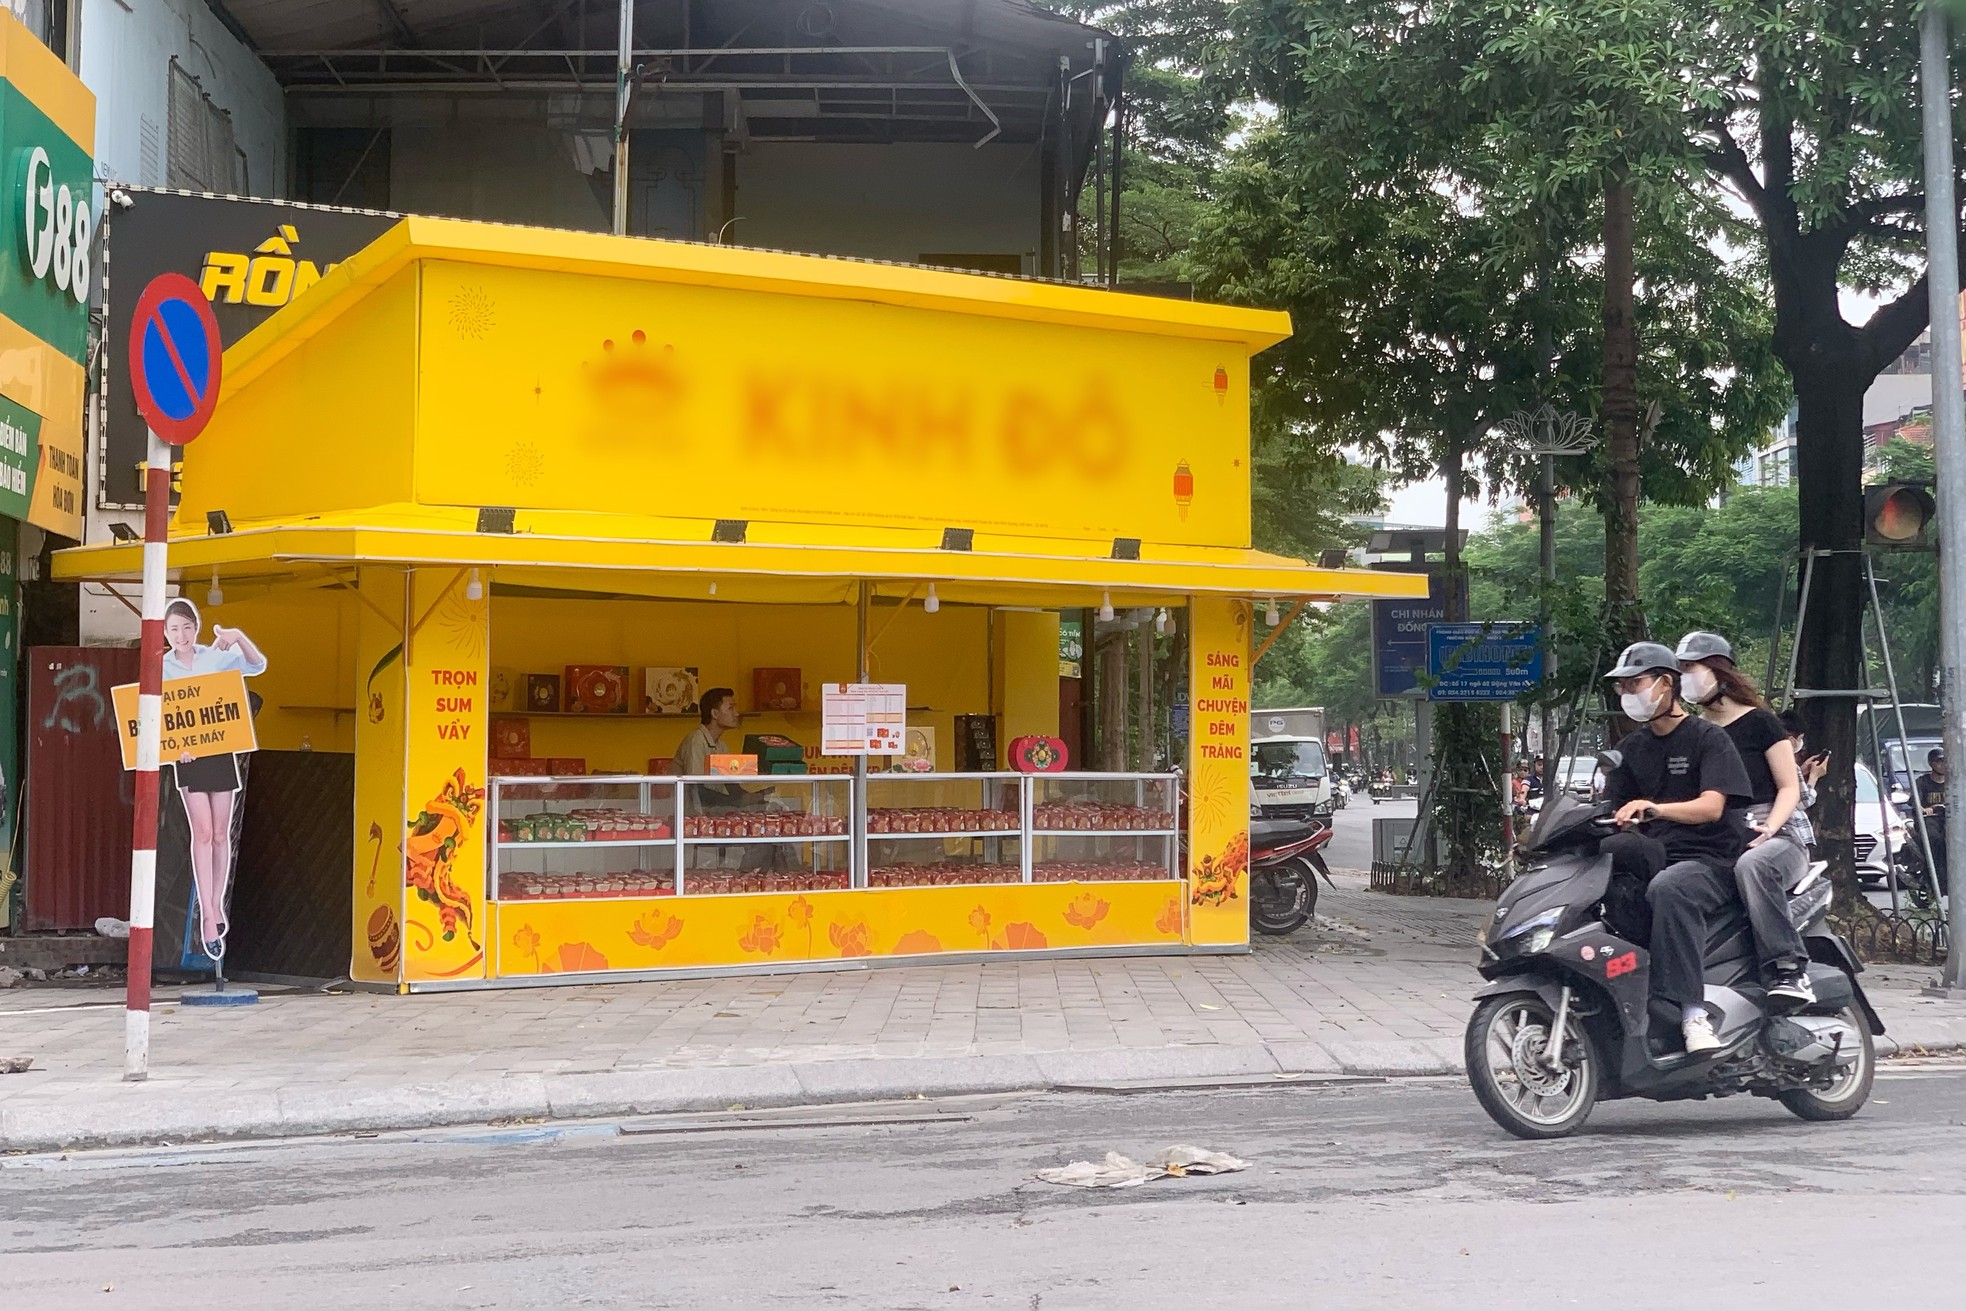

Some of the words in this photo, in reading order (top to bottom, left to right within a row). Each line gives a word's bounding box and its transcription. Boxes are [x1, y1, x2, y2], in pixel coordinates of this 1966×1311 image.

[1391, 609, 1410, 618] CHI
[1412, 607, 1444, 618] NHÁN
[1207, 651, 1239, 667] SÁNG
[431, 670, 477, 689] TRỌN
[1212, 674, 1234, 690] MÃI
[177, 686, 201, 700] ĐÂY
[436, 698, 472, 713] SUM
[1197, 698, 1247, 716] CHUYỆN
[163, 705, 196, 731] BẢO
[199, 697, 241, 726] HIỂM
[437, 719, 471, 740] VẦY
[1209, 720, 1235, 735] ĐÊM
[182, 735, 198, 747] XE
[200, 730, 226, 743] MÁY
[1201, 743, 1242, 759] TRĂNG
